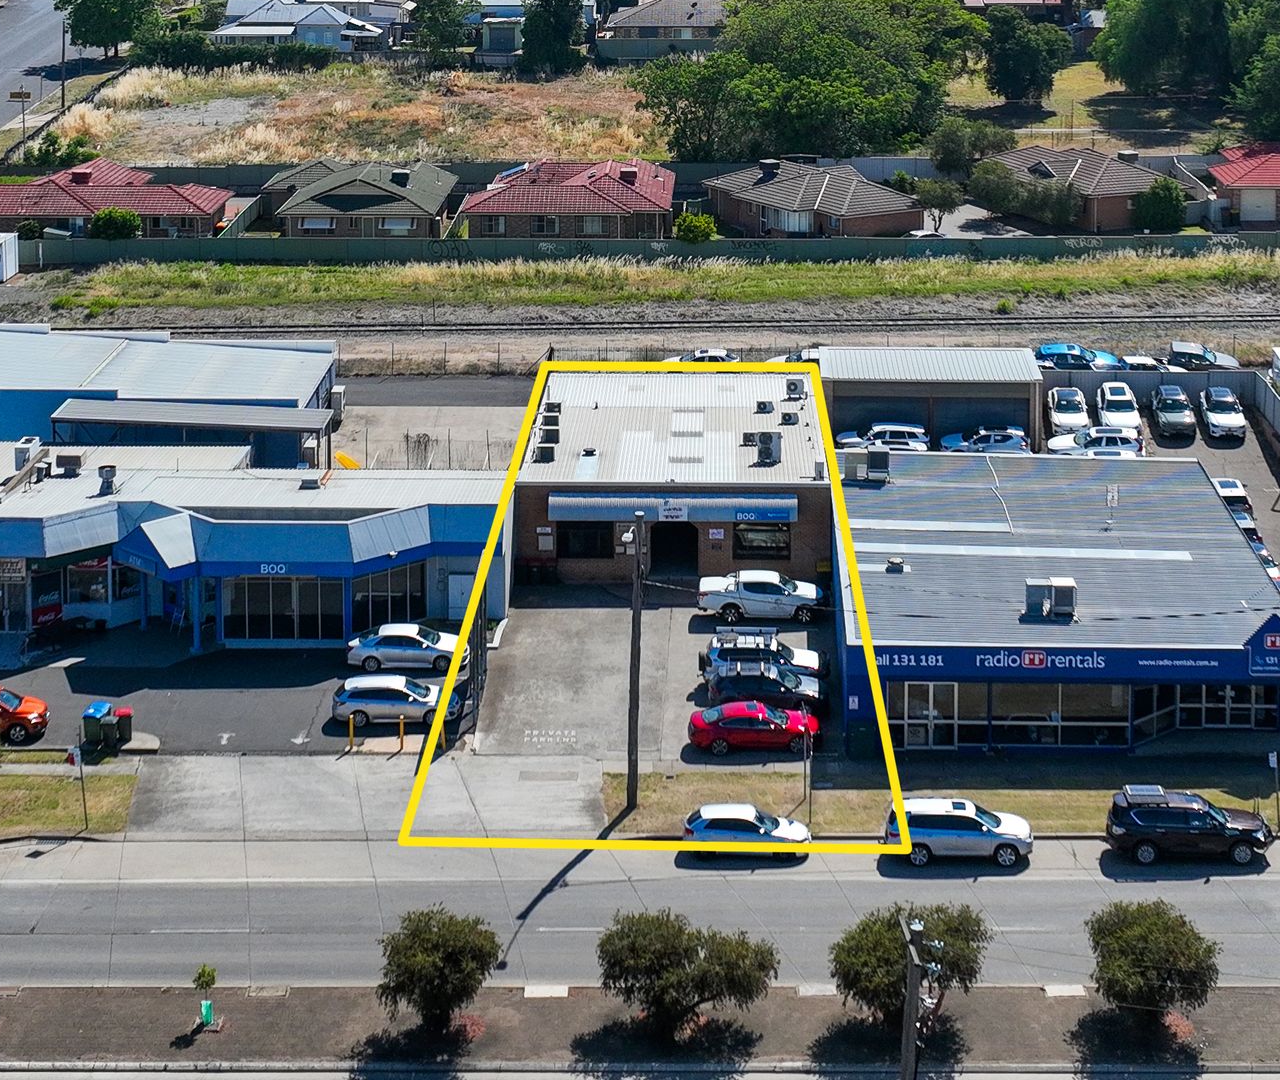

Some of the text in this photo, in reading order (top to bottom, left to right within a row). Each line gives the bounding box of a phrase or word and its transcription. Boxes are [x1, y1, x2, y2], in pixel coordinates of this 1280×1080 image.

[260, 563, 286, 574] BOQ
[892, 654, 916, 666] 131
[919, 654, 944, 666] 181
[976, 650, 1019, 667] radio
[1047, 652, 1105, 668] rentals
